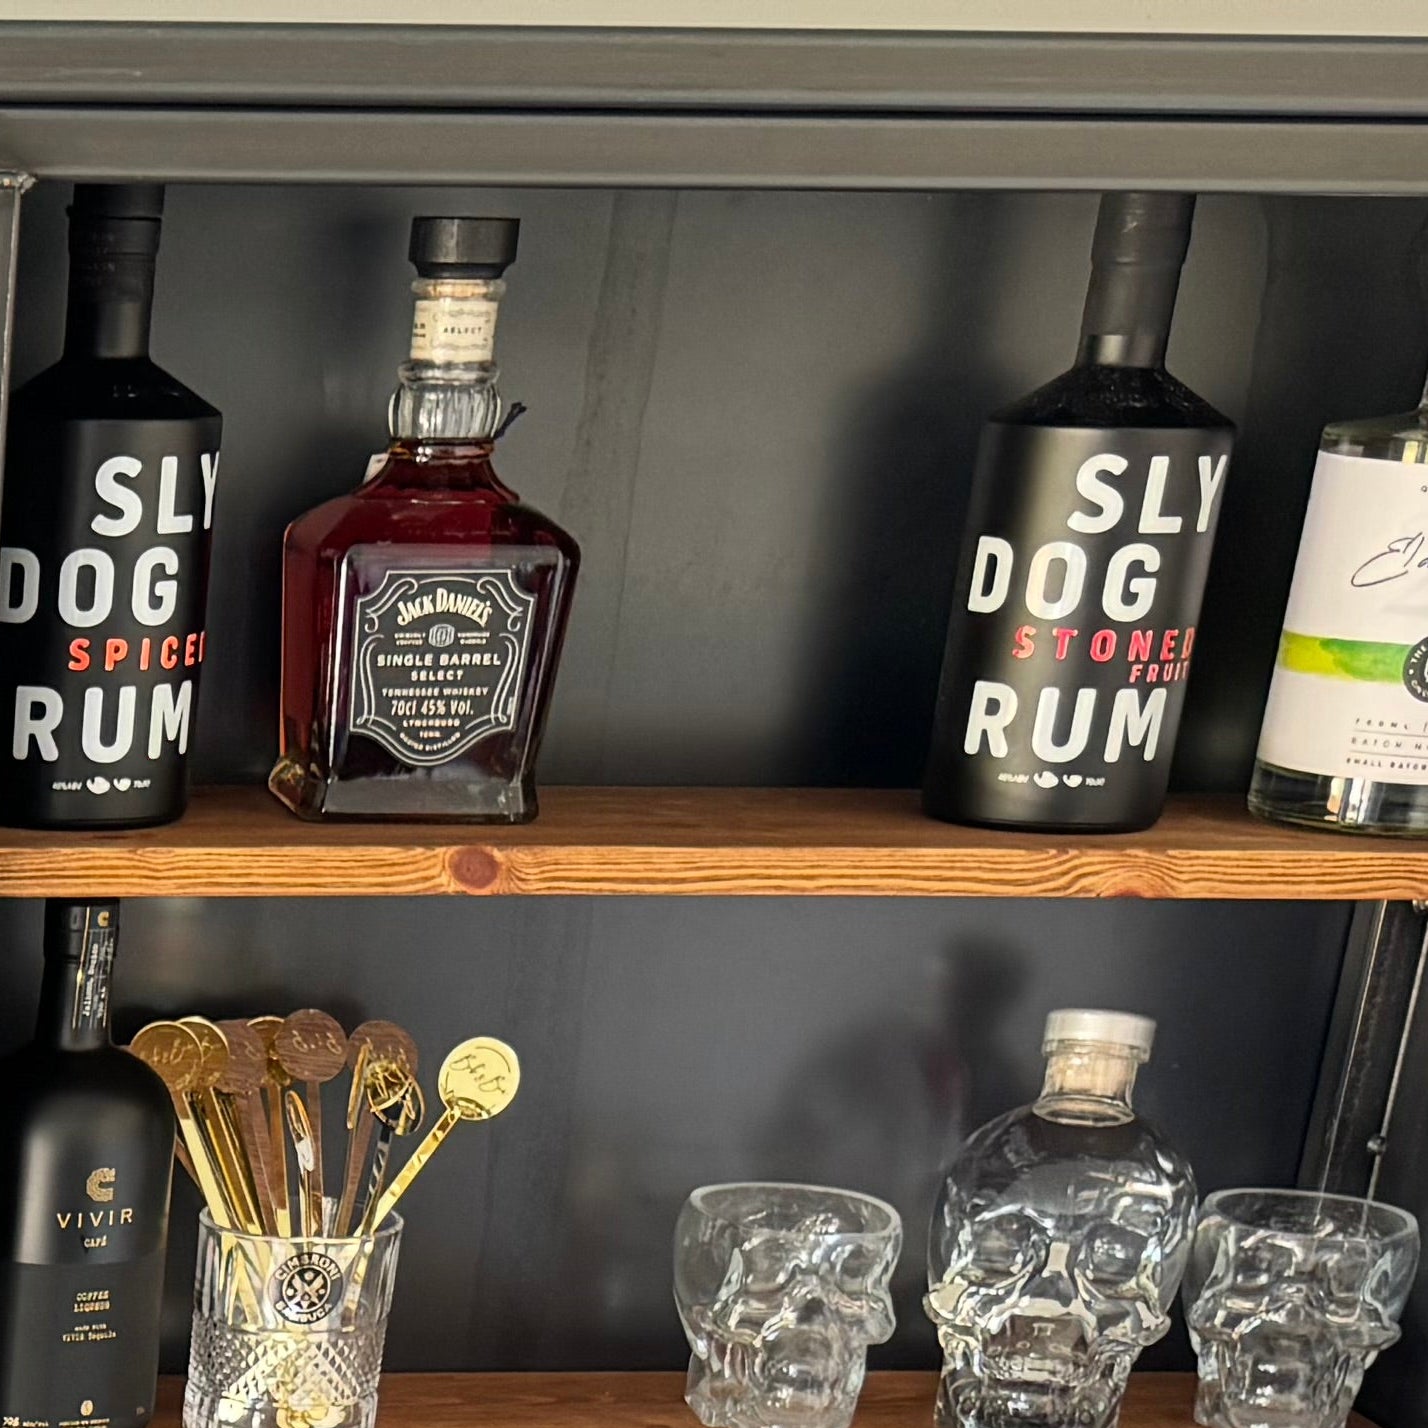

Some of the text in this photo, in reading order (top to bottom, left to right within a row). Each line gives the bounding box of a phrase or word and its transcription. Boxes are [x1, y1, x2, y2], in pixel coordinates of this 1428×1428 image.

[91, 452, 221, 537] SLY
[1067, 453, 1228, 534] SLY
[967, 535, 1161, 623] DOG
[397, 594, 435, 626] JACK
[377, 653, 502, 667] SINGLE BARREL
[410, 670, 464, 681] SELECT
[12, 680, 193, 764] RUM
[420, 700, 446, 716] 45%
[964, 680, 1167, 764] RUM
[56, 1208, 134, 1229] VIVIR
